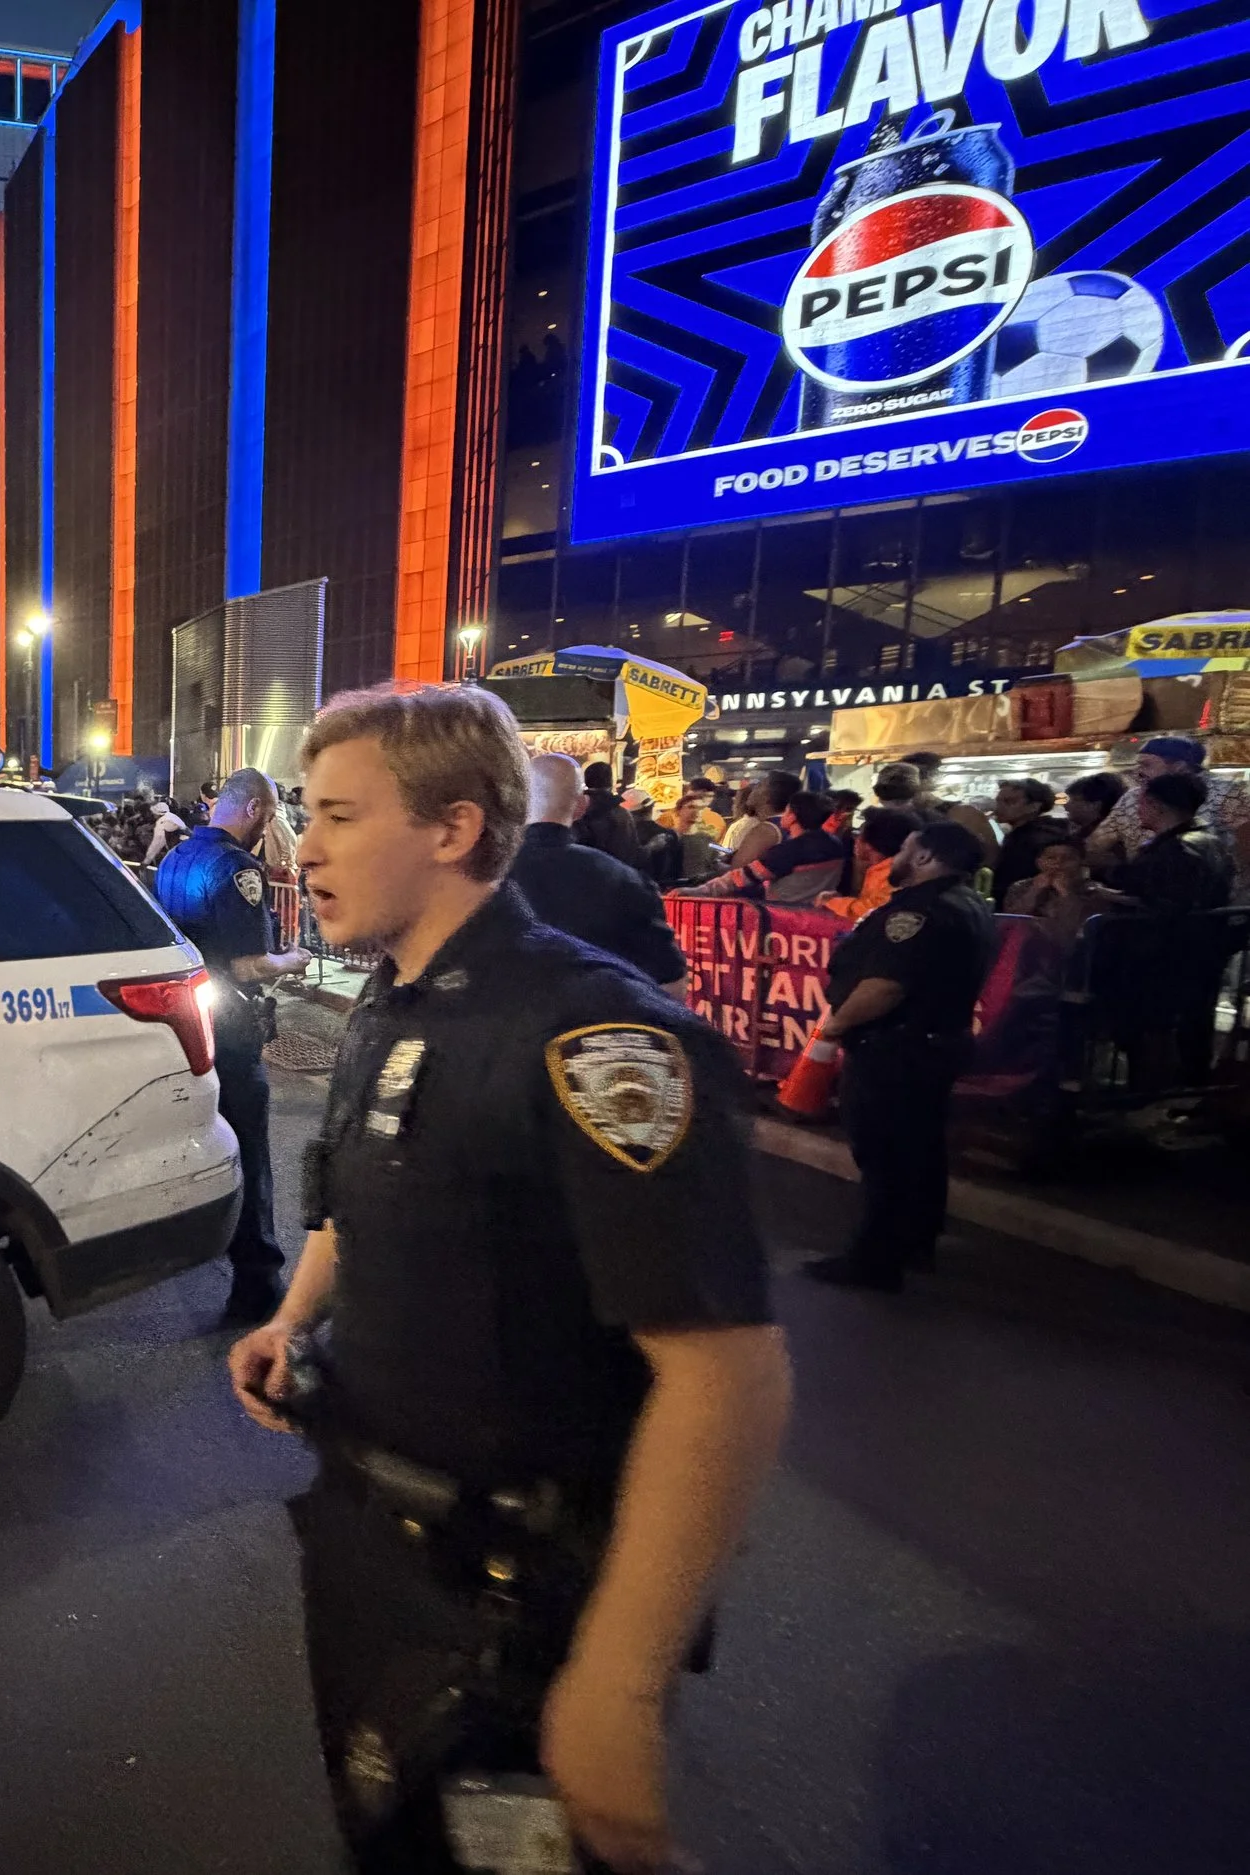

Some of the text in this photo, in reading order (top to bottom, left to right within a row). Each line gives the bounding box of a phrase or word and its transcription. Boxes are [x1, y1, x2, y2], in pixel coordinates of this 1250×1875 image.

[800, 244, 1014, 330] PEPSI
[830, 387, 954, 420] ZERO SUGAR
[713, 426, 1084, 498] FOOD DESERVES PEPSI
[628, 667, 701, 704] SABRETT
